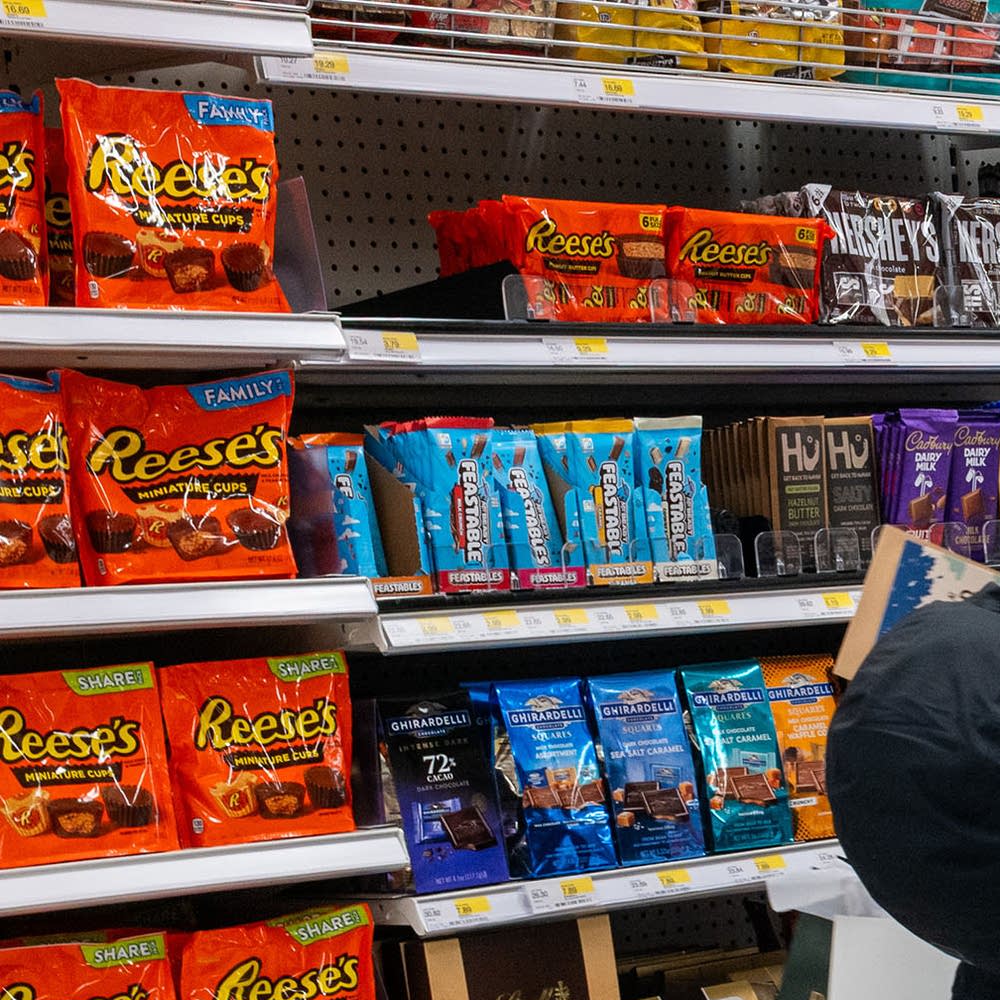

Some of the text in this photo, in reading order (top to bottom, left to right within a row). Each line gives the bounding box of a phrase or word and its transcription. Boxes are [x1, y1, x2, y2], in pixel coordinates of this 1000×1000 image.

[198, 101, 261, 125] FAMILY
[87, 134, 271, 201] Reese's
[212, 213, 244, 226] CUPS
[526, 218, 615, 259] Reese's
[831, 212, 940, 265] HERSHEY'S
[680, 230, 772, 266] Reese's
[205, 382, 273, 405] FAMILY
[905, 430, 953, 455] Cadbury
[954, 426, 1000, 450] Cadbury
[88, 426, 282, 482] Reese's
[915, 453, 942, 462] DAIRY
[964, 447, 991, 457] DAIRY
[915, 461, 937, 472] MILK
[965, 457, 987, 467] MILK
[138, 481, 248, 500] MINIATURE CUPS
[459, 459, 482, 565] FEASTABLE
[667, 461, 687, 554] FEASTABLE
[788, 506, 820, 519] BUTTER
[449, 571, 504, 585] FEASTABLES
[530, 571, 577, 585] FEASTABLES
[597, 564, 647, 579] FEASTABLES
[663, 563, 712, 578] FEASTABLES
[374, 581, 423, 594] FEASTABLES
[277, 658, 328, 677] SHARE
[78, 672, 135, 690] SHARE
[694, 690, 763, 705] GHIRARDELLI
[603, 701, 674, 717] GHIRARDELLI
[197, 698, 337, 750] Reese's
[391, 714, 467, 732] GHIRARDELLI
[511, 711, 583, 725] GHIRARDELLI
[0, 709, 139, 760] Reese's
[531, 730, 572, 742] SQUARES
[622, 724, 662, 733] SQUARES
[736, 733, 772, 744] CARAMEL
[292, 749, 319, 761] CUPS
[611, 745, 684, 760] SEA SALT CARAMEL
[25, 769, 114, 782] MINIATURE CUPS
[426, 773, 454, 783] CACAO
[439, 780, 470, 791] CHOCOLATE
[297, 915, 354, 941] SHARE
[94, 944, 150, 962] SHARE
